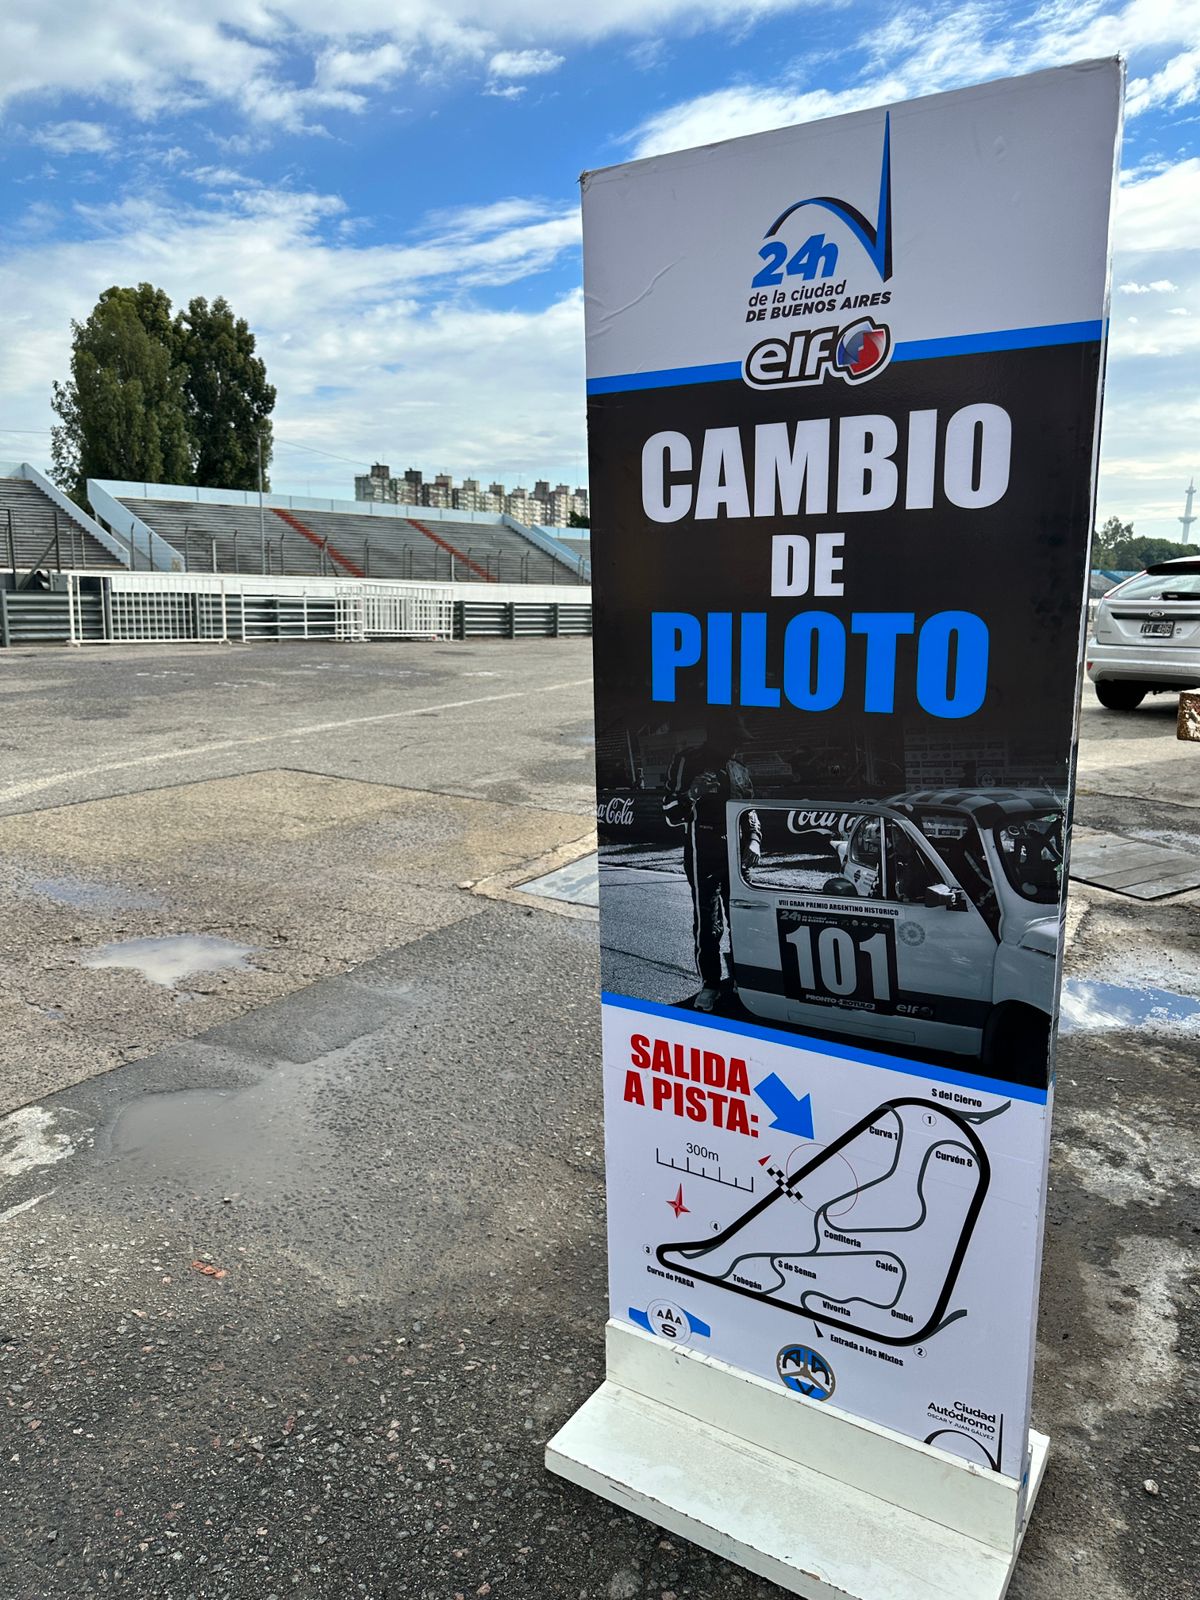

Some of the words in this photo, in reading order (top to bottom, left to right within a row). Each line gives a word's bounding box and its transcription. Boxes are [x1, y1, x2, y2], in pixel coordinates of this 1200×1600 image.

[751, 233, 839, 289] 24h
[749, 292, 768, 307] de
[772, 290, 786, 304] la
[791, 280, 847, 302] ciudad
[745, 308, 767, 323] DE
[770, 299, 837, 320] BUENOS
[840, 291, 892, 310] AIRES
[747, 328, 838, 382] elf
[641, 403, 1012, 523] CAMBIO
[771, 532, 846, 598] DE
[651, 610, 990, 719] PILOTO
[778, 899, 789, 907] VIII
[790, 900, 805, 908] GRAN
[806, 902, 829, 910] PREMIO
[829, 904, 863, 912] ARGENTINO
[864, 907, 899, 916] HISTORICO
[785, 925, 891, 1001] 101
[896, 1004, 920, 1014] elf
[630, 1033, 751, 1096] SALIDA
[623, 1069, 646, 1106] A
[652, 1076, 759, 1138] PISTA:
[931, 1088, 938, 1097] S
[938, 1090, 953, 1101] del
[954, 1093, 982, 1108] Ciervo
[869, 1126, 893, 1139] Curva
[893, 1132, 898, 1141] 1
[685, 1142, 720, 1162] 300m
[935, 1150, 966, 1166] Curvón
[966, 1158, 973, 1168] 8
[646, 1265, 665, 1278] Curva
[665, 1272, 674, 1281] de
[778, 1260, 783, 1268] S
[784, 1262, 793, 1272] de
[794, 1265, 817, 1280] Senna
[875, 1260, 899, 1274] Cajón
[732, 1273, 762, 1290] Tobogán
[822, 1300, 851, 1317] Vivorita
[891, 1309, 914, 1323] Ombú
[830, 1334, 858, 1351] Entrada
[865, 1346, 877, 1357] los
[878, 1350, 904, 1367] Mixtos
[916, 1347, 923, 1356] 2
[927, 1402, 995, 1433] Autódromo
[927, 1412, 948, 1423] OSCAR
[954, 1422, 970, 1432] JUAN
[953, 1401, 996, 1424] Ciudad
